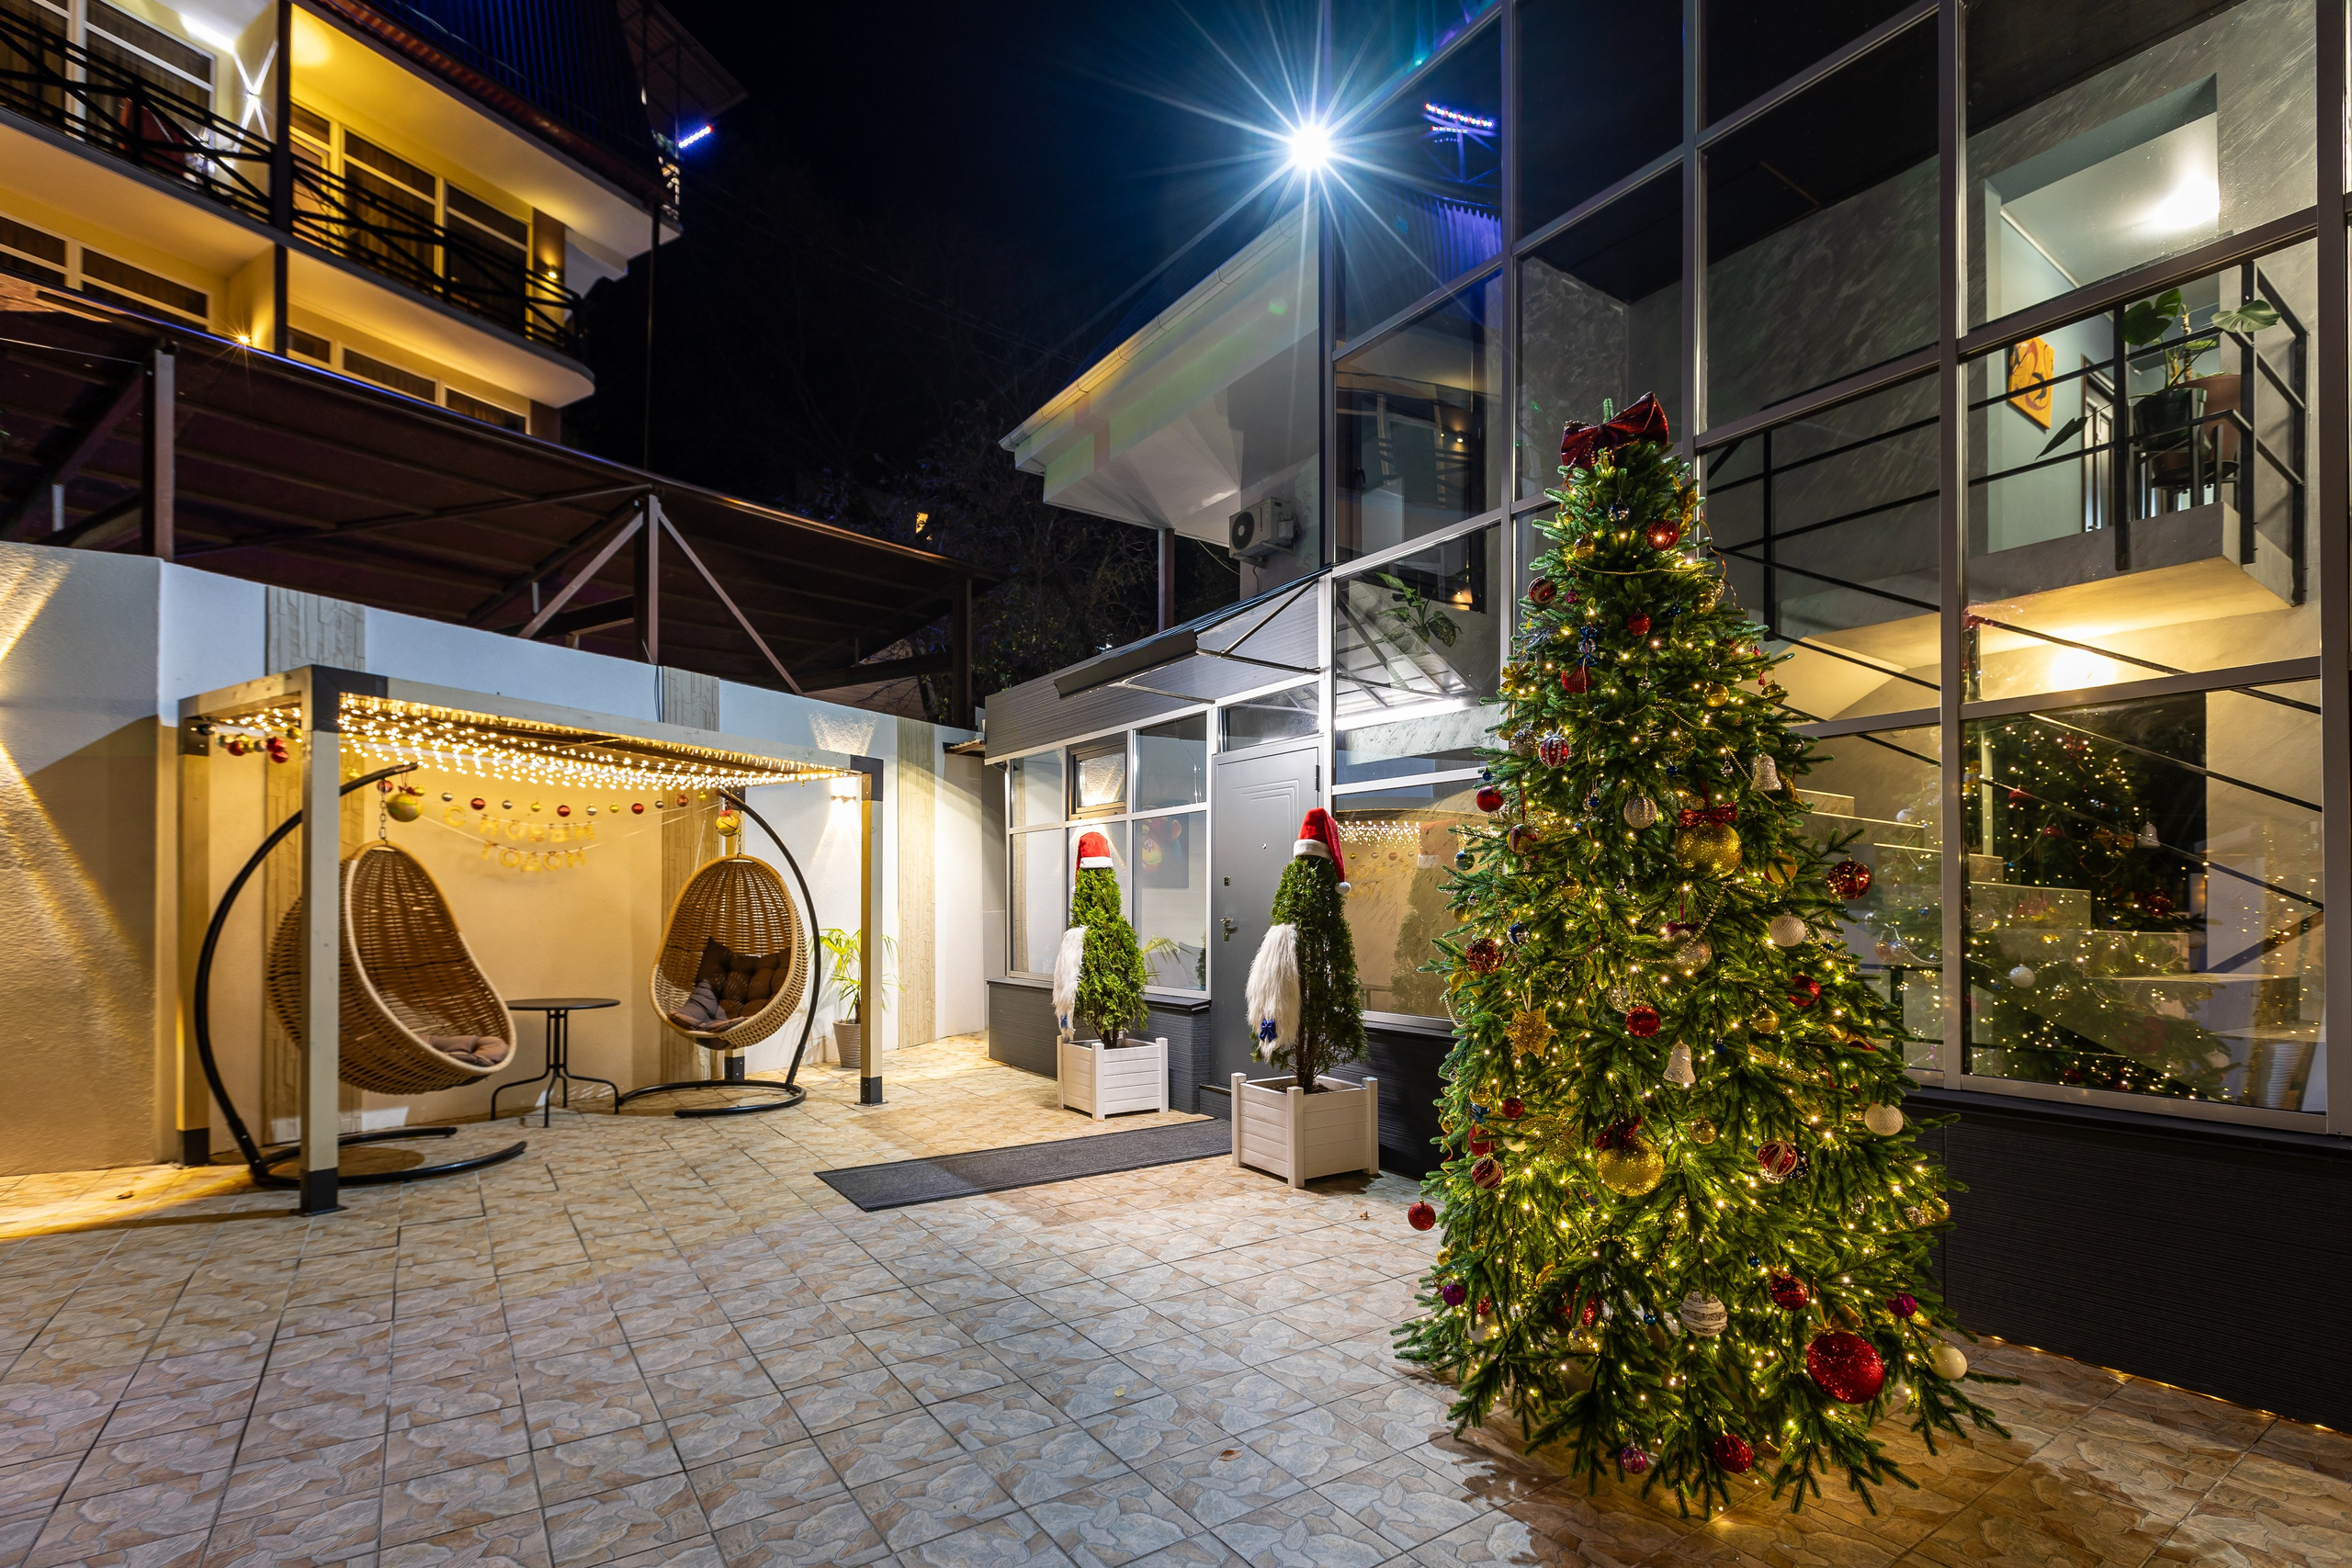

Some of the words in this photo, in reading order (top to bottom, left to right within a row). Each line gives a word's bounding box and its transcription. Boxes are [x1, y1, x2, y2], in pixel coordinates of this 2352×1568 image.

[443, 805, 466, 827] С
[479, 816, 595, 843] НОВЫМ
[481, 840, 586, 873] ГОДОМ
